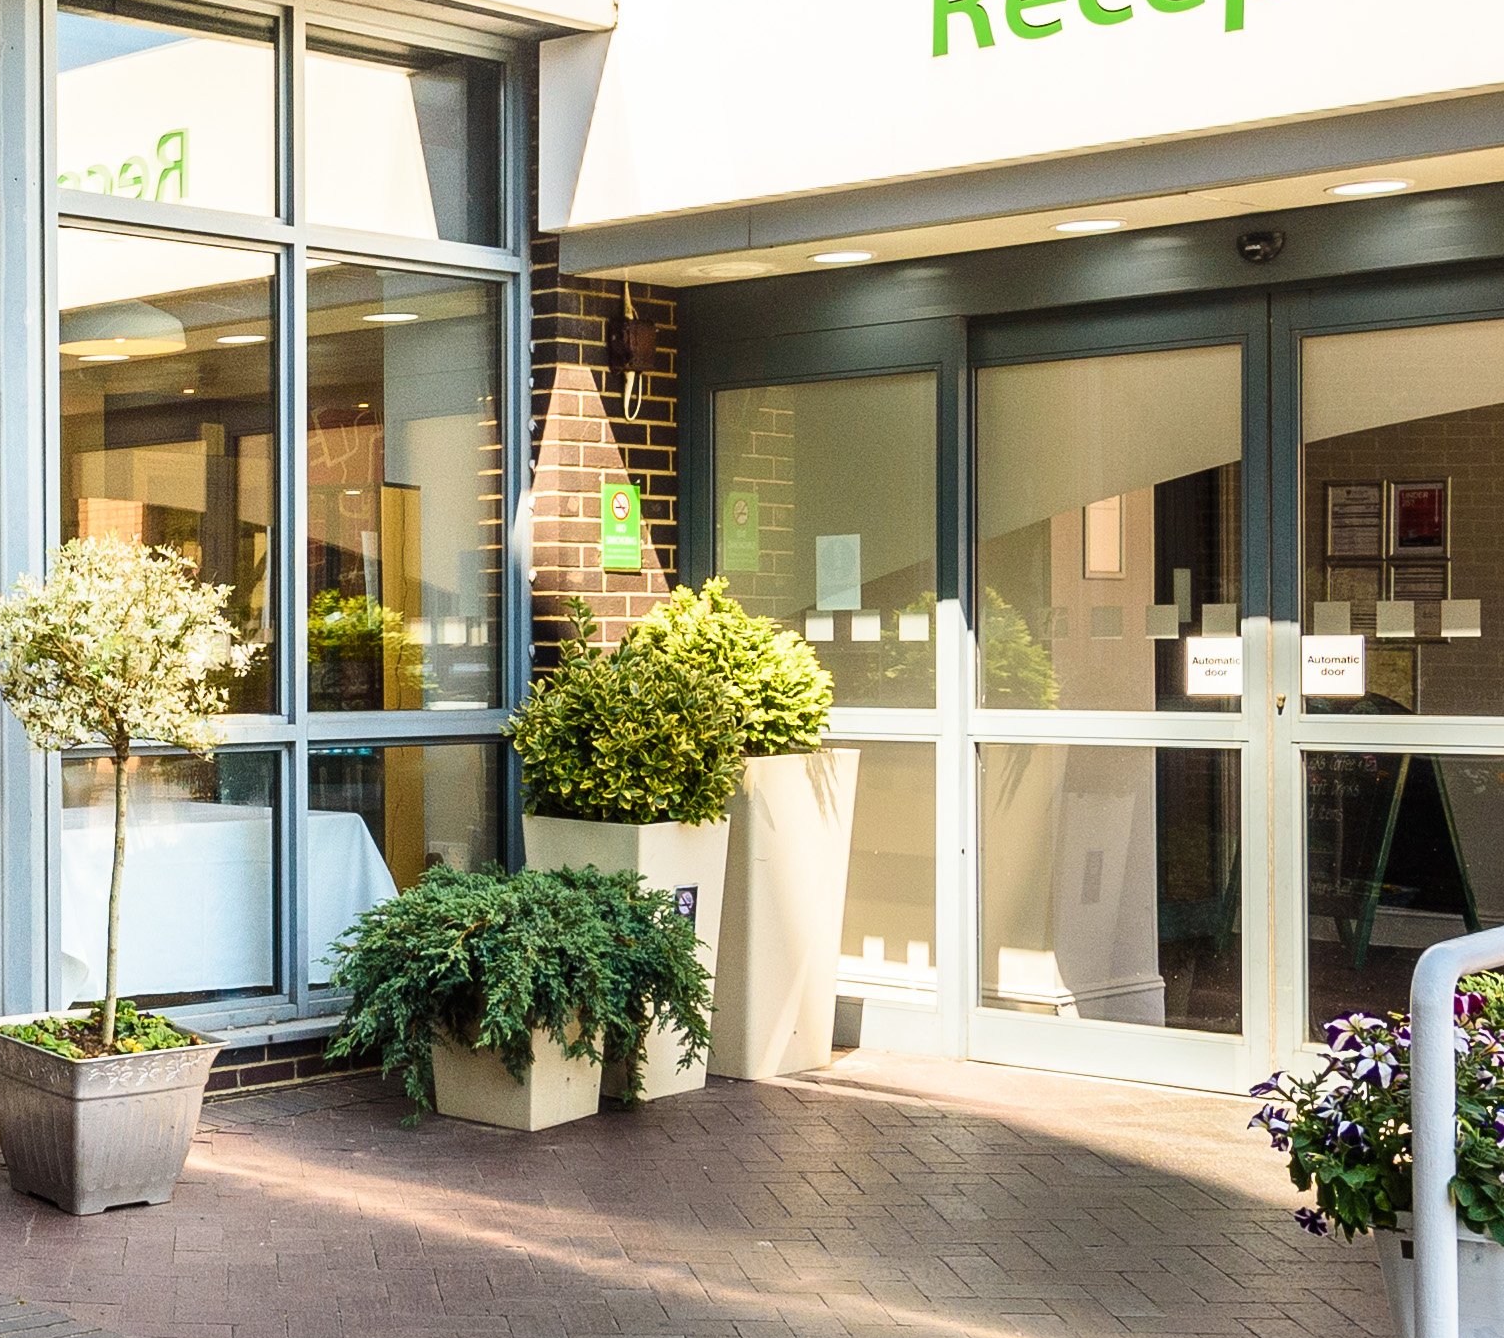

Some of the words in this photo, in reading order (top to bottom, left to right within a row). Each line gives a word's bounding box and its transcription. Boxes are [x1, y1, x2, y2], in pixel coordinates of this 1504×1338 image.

[1192, 657, 1241, 665] Automatic
[1307, 656, 1360, 664] Automatic
[1205, 669, 1228, 677] door
[1321, 668, 1345, 676] door
